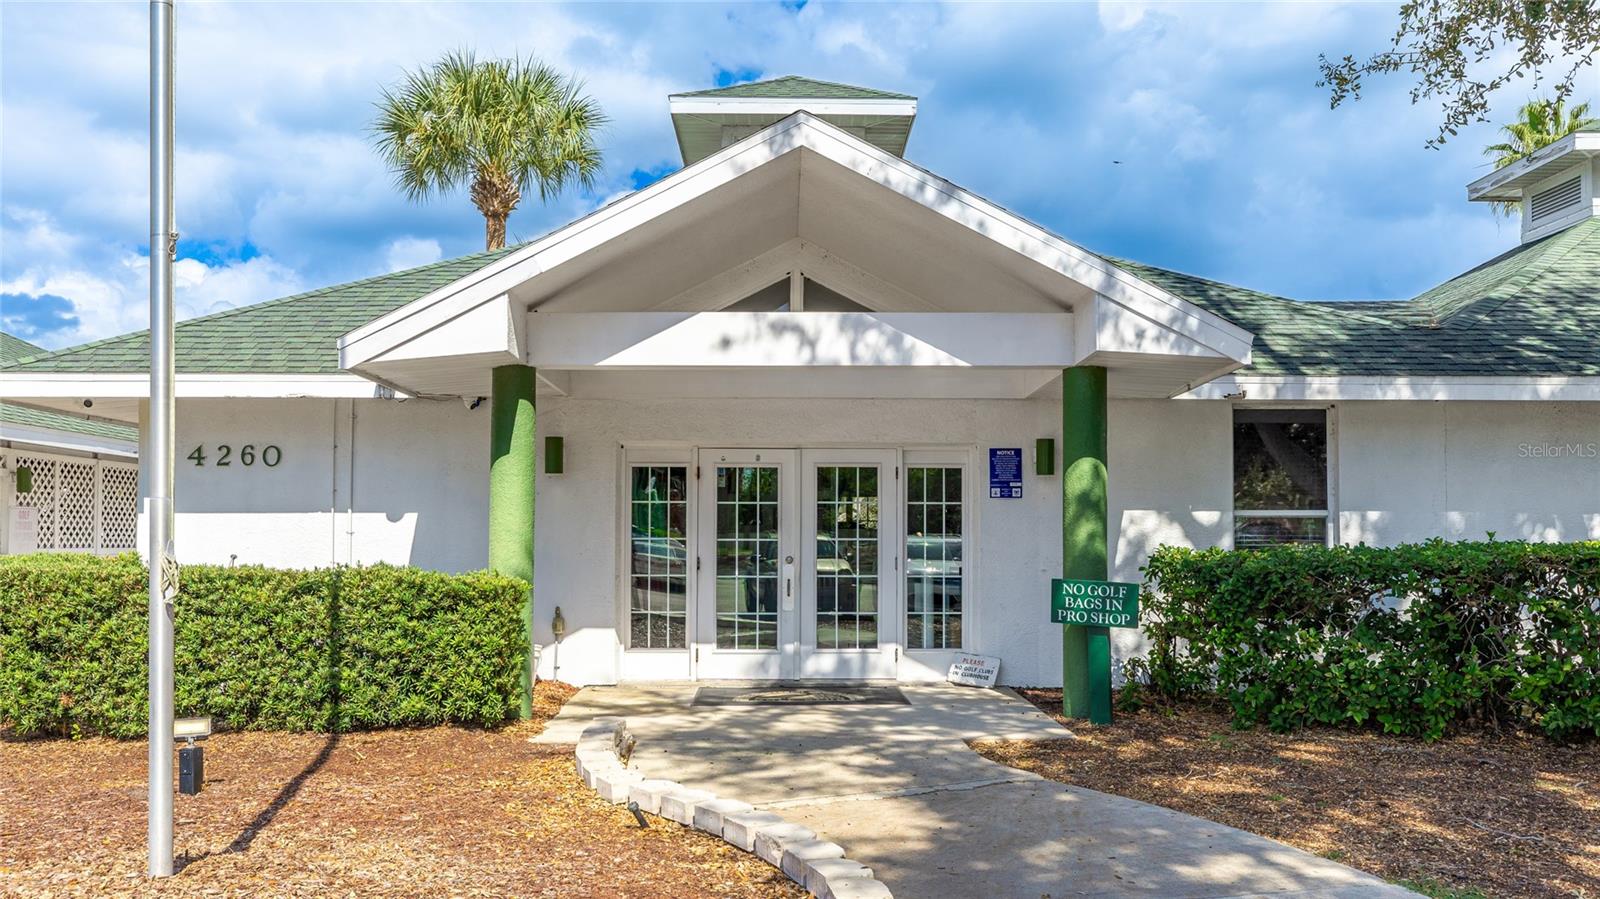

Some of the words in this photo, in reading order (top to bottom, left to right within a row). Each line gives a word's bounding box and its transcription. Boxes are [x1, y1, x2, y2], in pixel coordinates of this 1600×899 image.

[187, 444, 282, 467] 4260
[1062, 582, 1085, 595] NO
[1087, 584, 1127, 598] GOLF
[1065, 596, 1102, 609] BAGS
[1105, 598, 1123, 611] IN
[1057, 609, 1088, 622] PRO
[1090, 611, 1130, 625] SHOP
[961, 657, 985, 666] PLEASE
[961, 671, 990, 681] CLUBHOUSE
